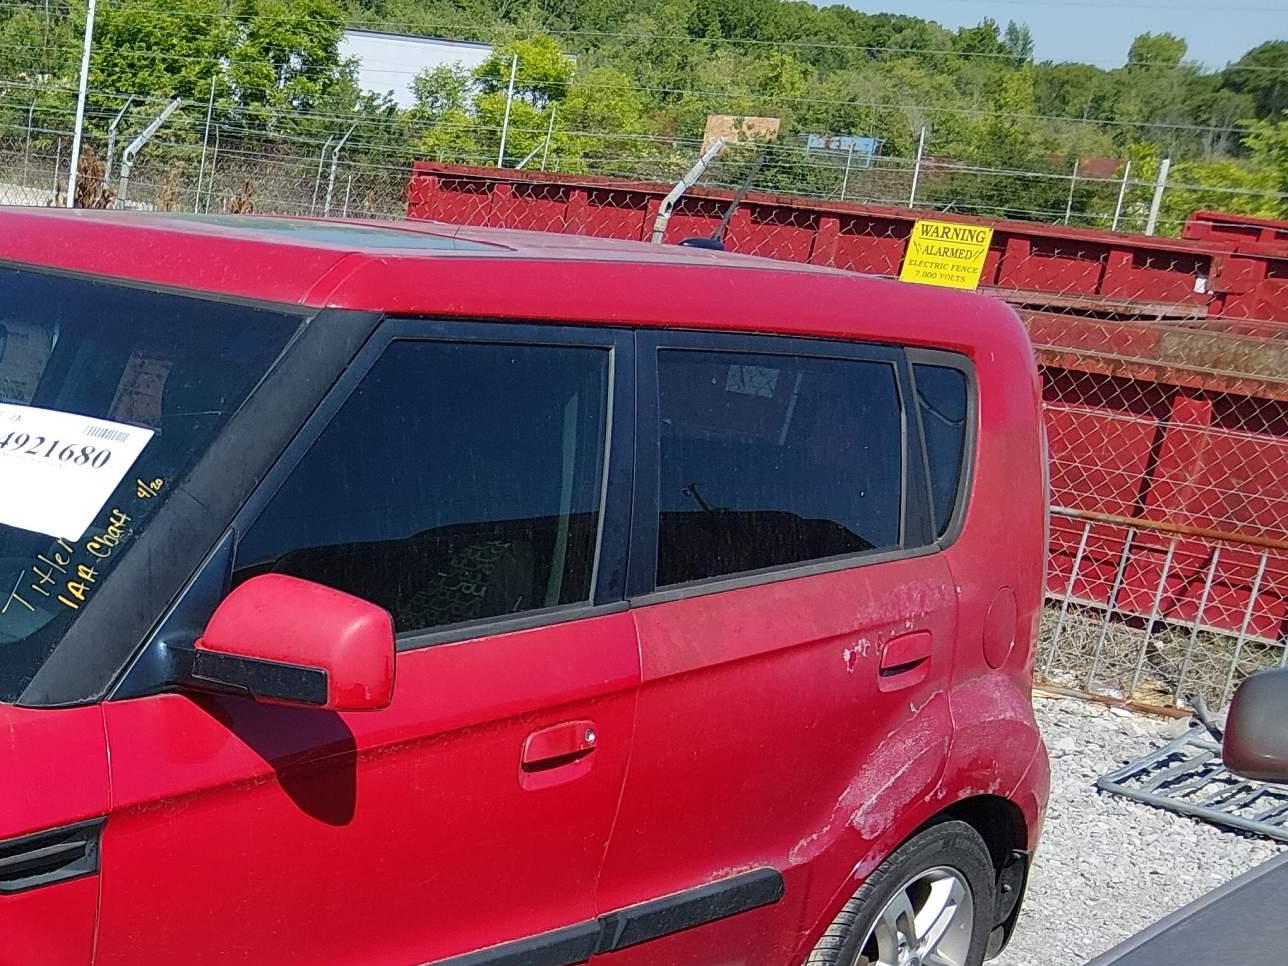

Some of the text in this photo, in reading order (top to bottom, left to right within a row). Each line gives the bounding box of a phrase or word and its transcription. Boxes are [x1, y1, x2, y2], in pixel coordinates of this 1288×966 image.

[920, 223, 986, 243] WARNING
[922, 245, 973, 260] ALARMED
[908, 259, 978, 274] ELECTRIC FENCE
[940, 273, 967, 283] VOLTS
[136, 478, 164, 499] 4/20
